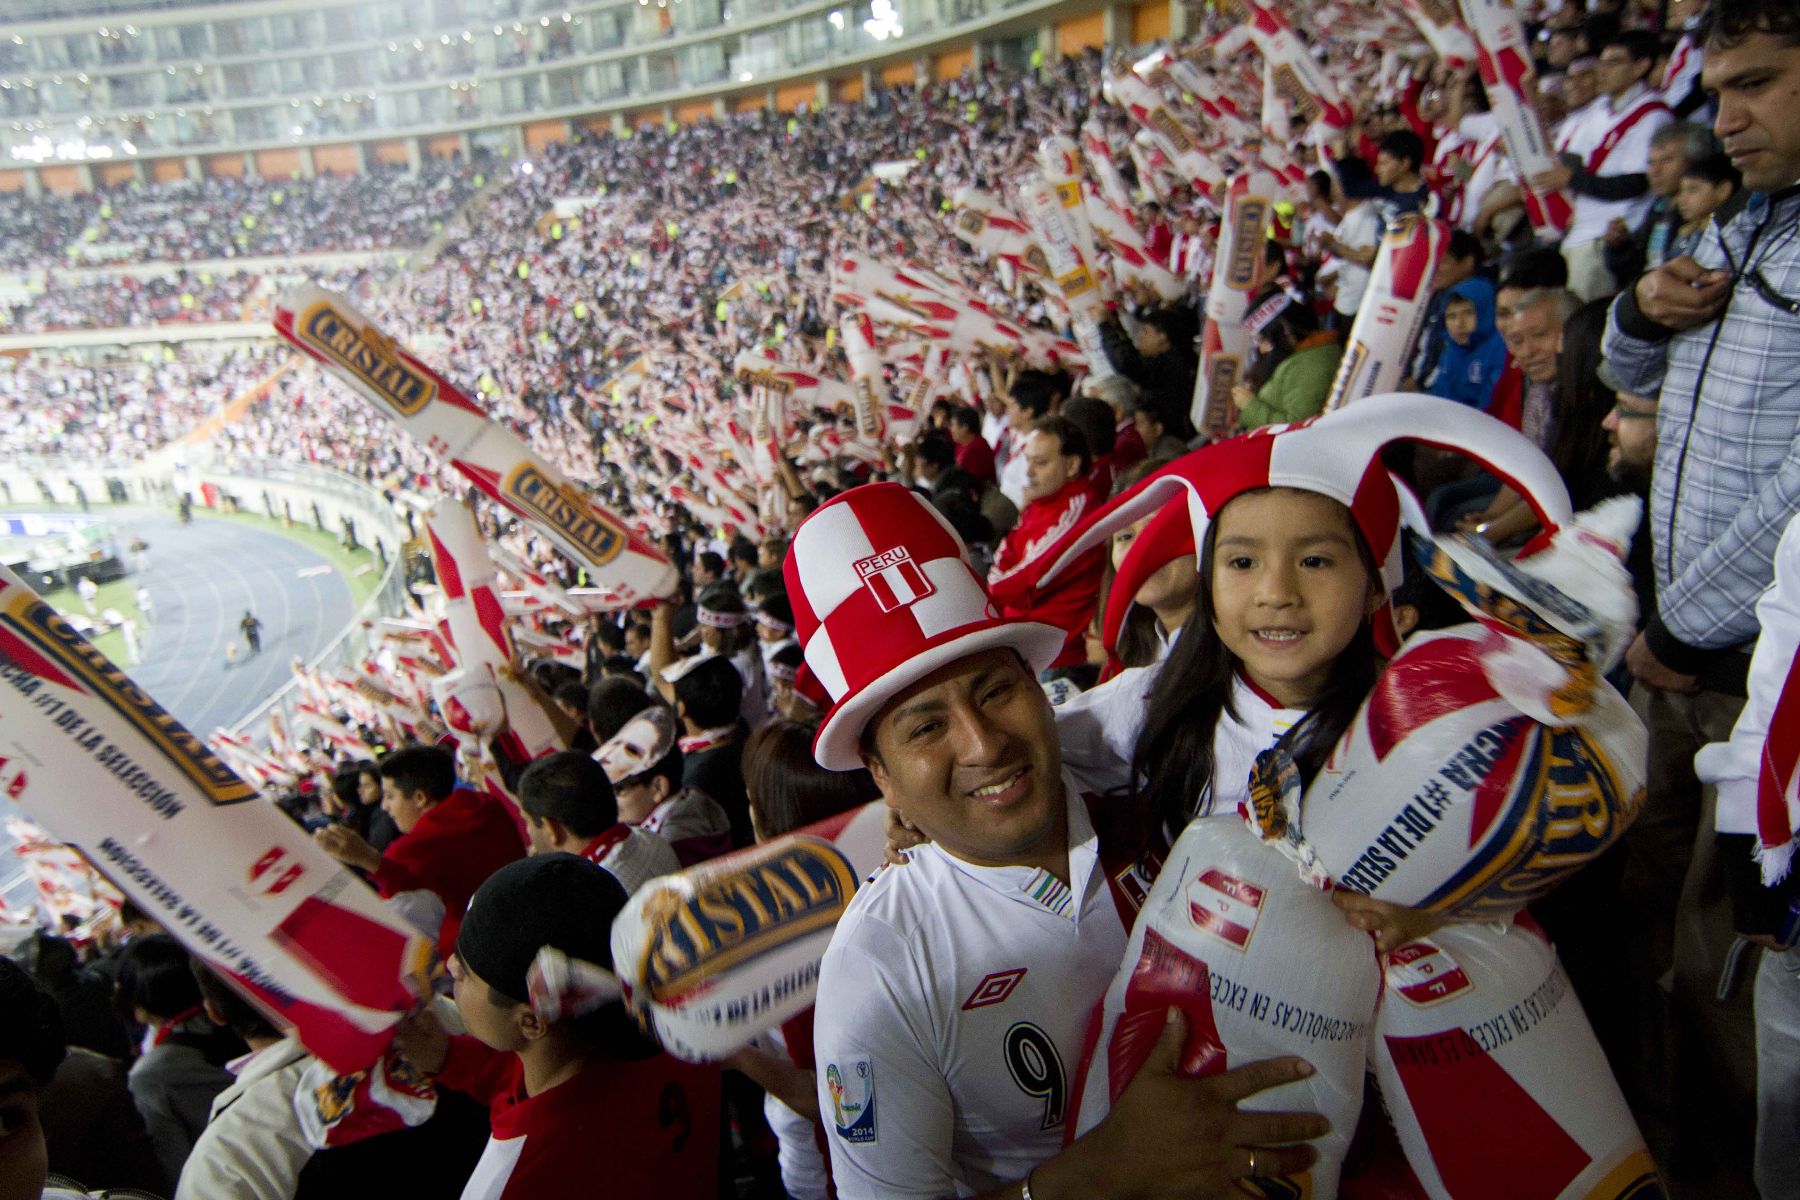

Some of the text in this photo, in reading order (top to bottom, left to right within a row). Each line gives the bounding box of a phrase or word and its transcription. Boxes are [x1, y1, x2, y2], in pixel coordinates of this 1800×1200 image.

[315, 314, 417, 404] CRISTAL
[519, 474, 611, 553] CRISTAL
[859, 547, 906, 574] PERU
[53, 709, 87, 735] DE
[74, 727, 105, 752] LA
[1415, 778, 1454, 821] #1
[1376, 824, 1409, 861] LA
[1393, 804, 1439, 851] DE
[1249, 991, 1271, 1022] EN
[1508, 1004, 1530, 1036] EN
[1003, 1021, 1067, 1130] 9
[852, 1126, 874, 1137] 2014
